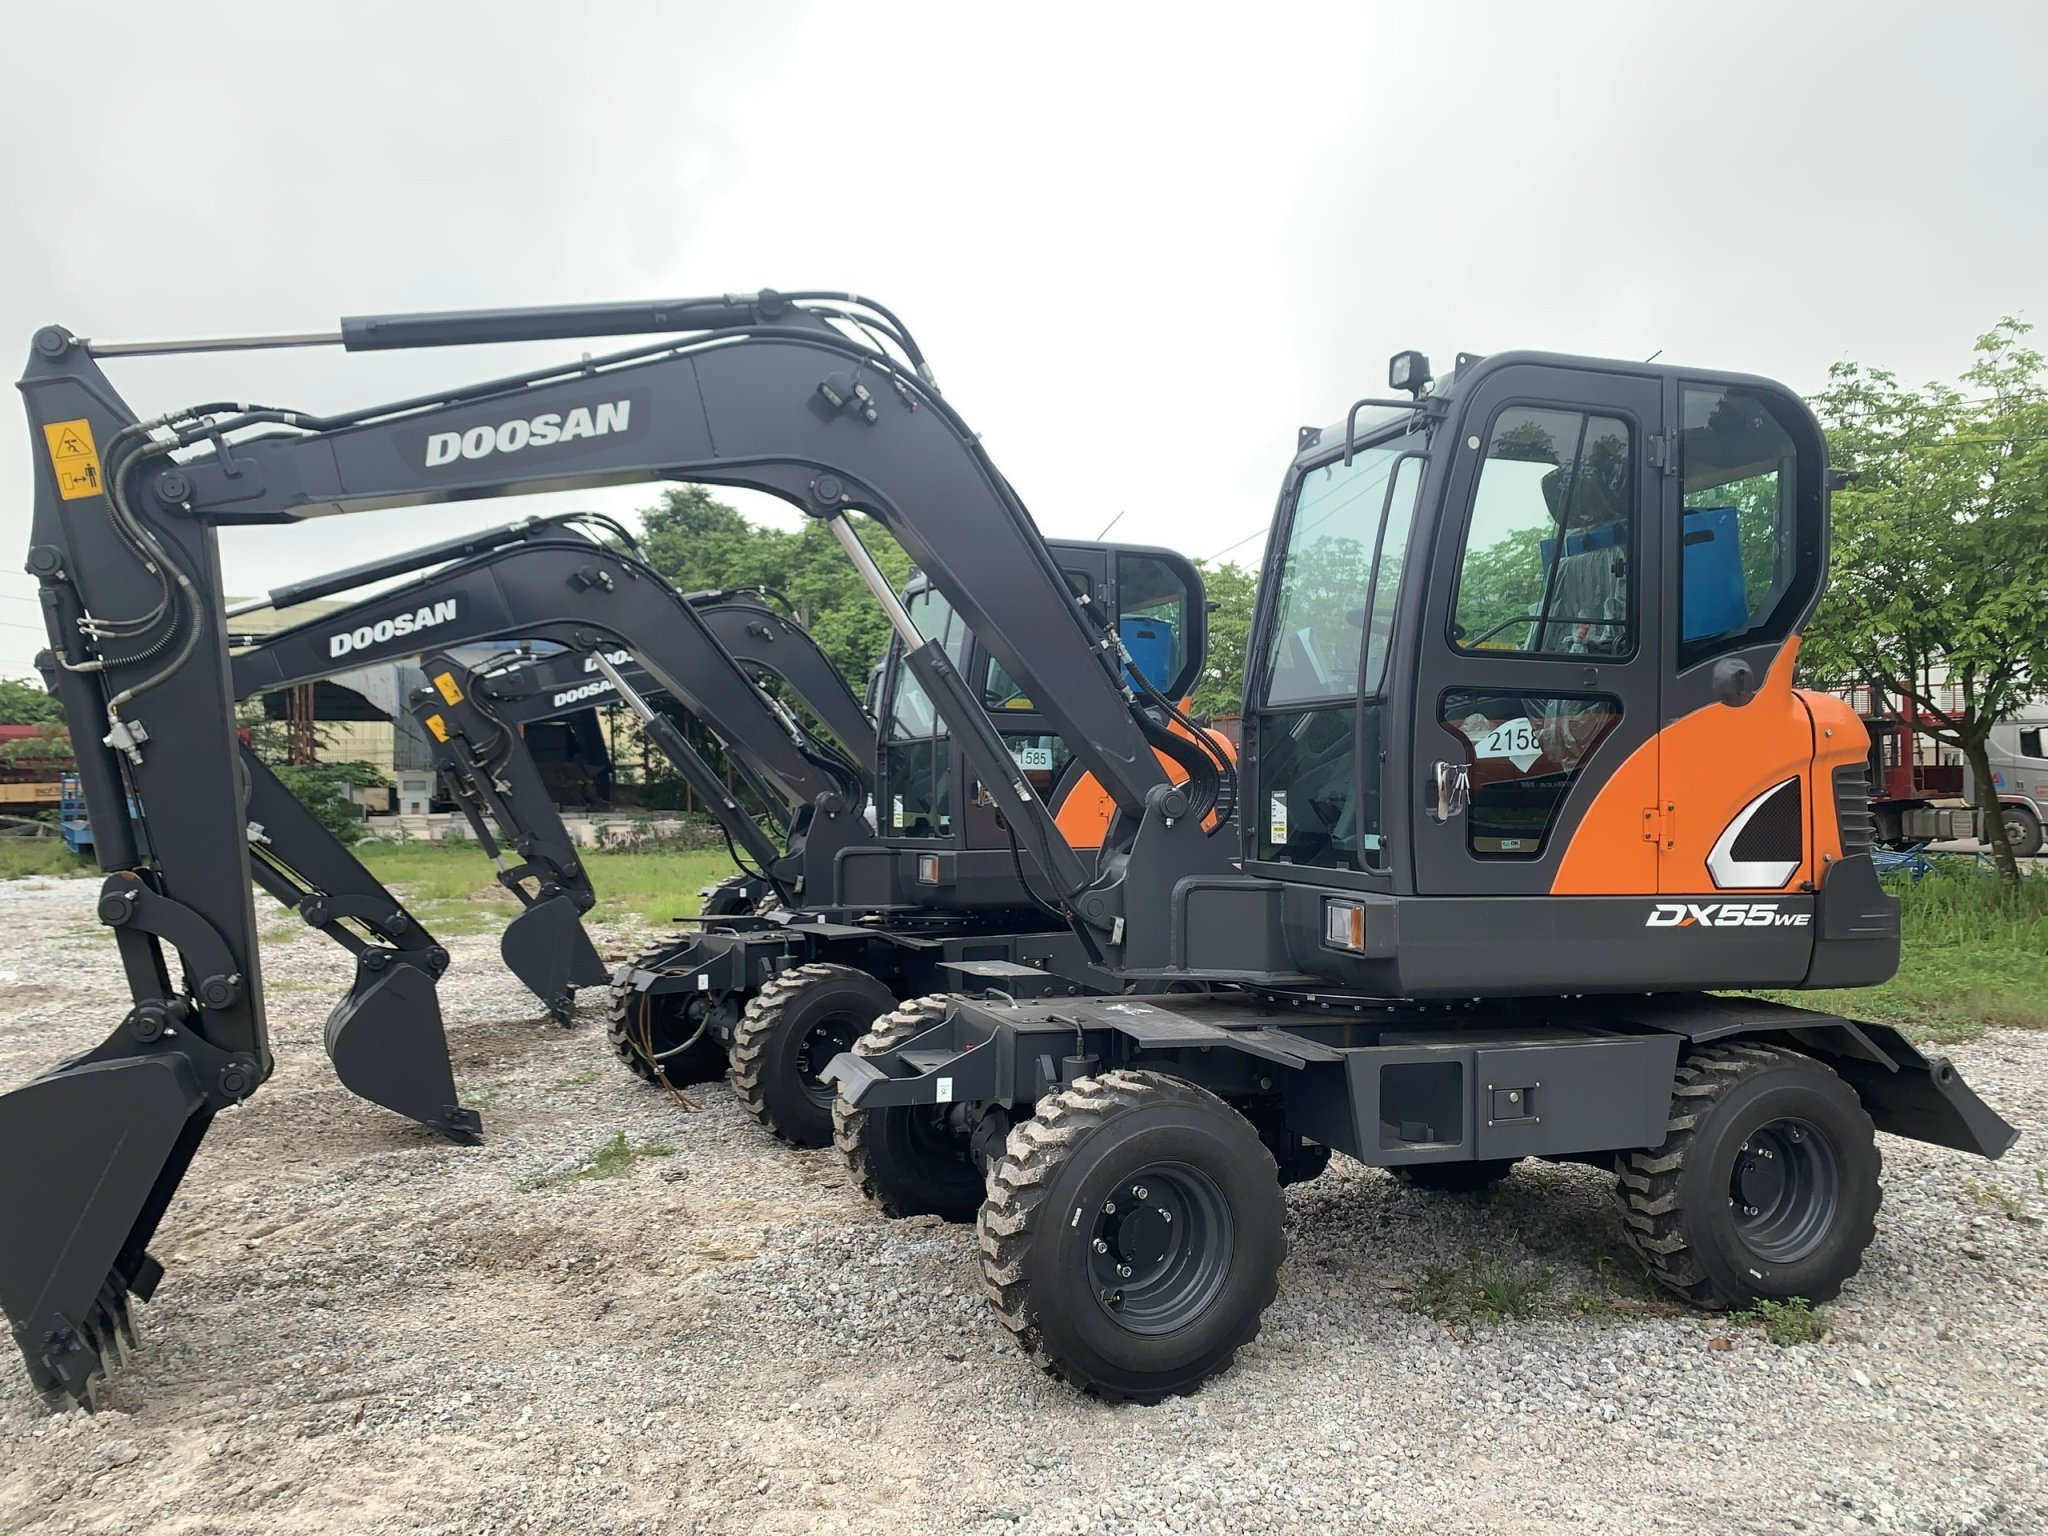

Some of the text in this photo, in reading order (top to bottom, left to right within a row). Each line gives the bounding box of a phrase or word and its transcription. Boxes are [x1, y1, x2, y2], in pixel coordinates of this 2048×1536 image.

[425, 400, 630, 467] DOOSAN
[329, 599, 457, 658] DOOSAN
[554, 680, 616, 708] DOOSA
[1645, 904, 1811, 927] DX55WE
